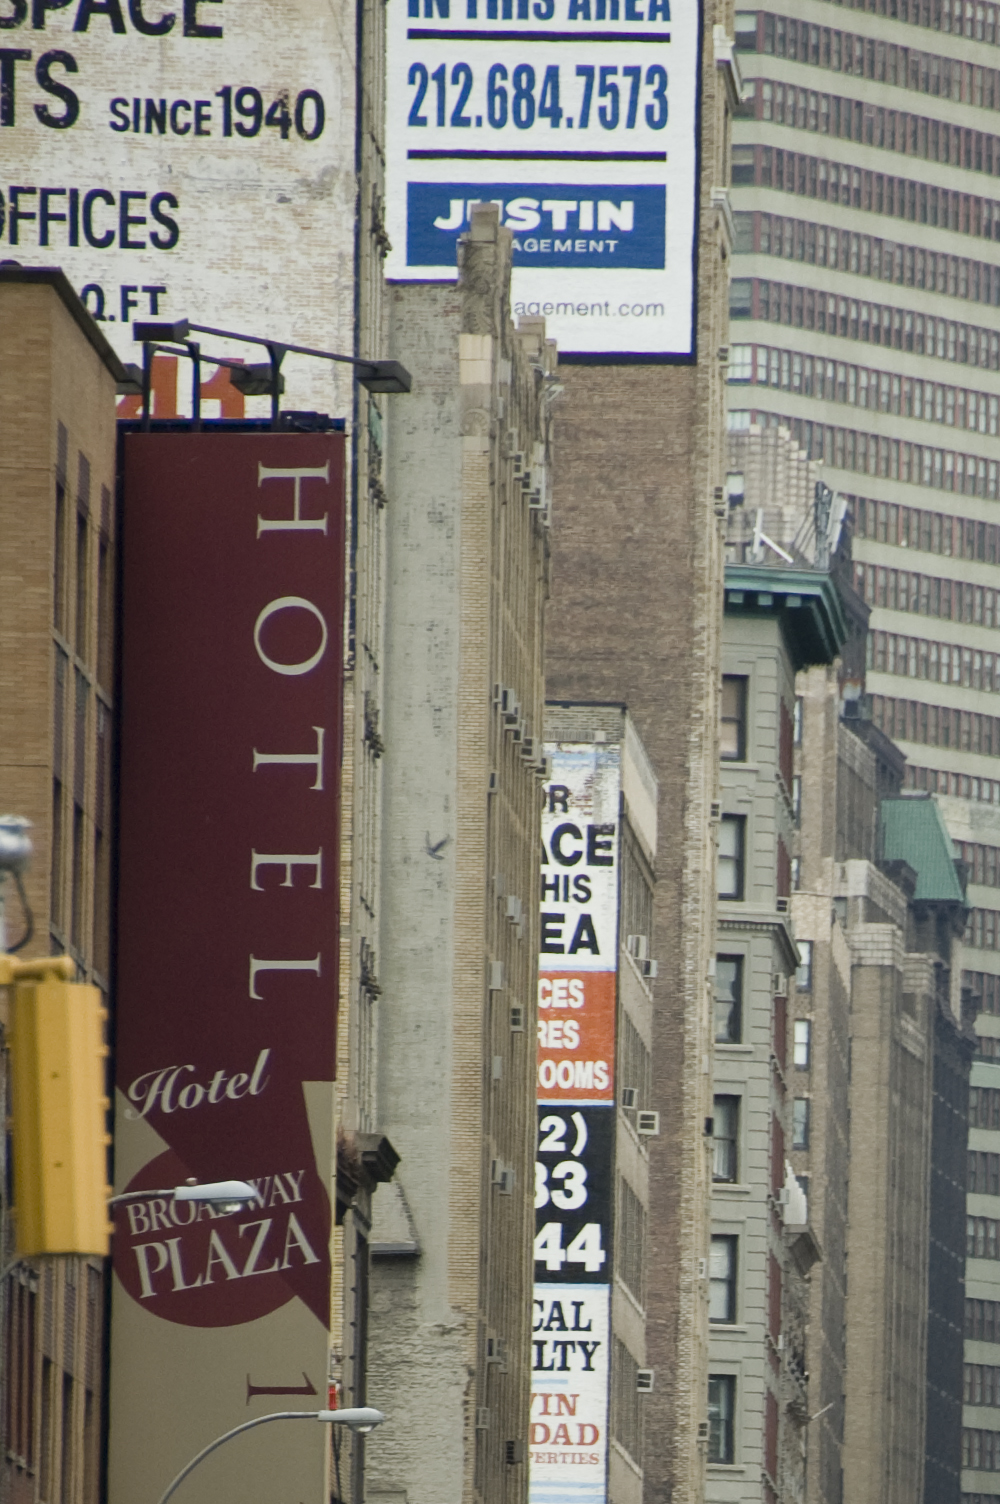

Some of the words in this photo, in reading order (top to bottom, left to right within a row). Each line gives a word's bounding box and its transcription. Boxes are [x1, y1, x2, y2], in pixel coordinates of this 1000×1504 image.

[0, 48, 80, 129] TS
[109, 97, 212, 136] SINCE
[214, 86, 325, 141] 1940
[407, 62, 669, 130] 212.684.7573
[0, 185, 179, 249] FFICES
[433, 197, 634, 231] JSTIN
[248, 460, 331, 1000] HOTEL
[541, 785, 569, 813] R
[540, 913, 600, 955] EA
[124, 1048, 271, 1120] Hotel
[126, 1170, 306, 1236] BROAWAY
[132, 1211, 321, 1299] PLAZA
[533, 1222, 606, 1272] 44
